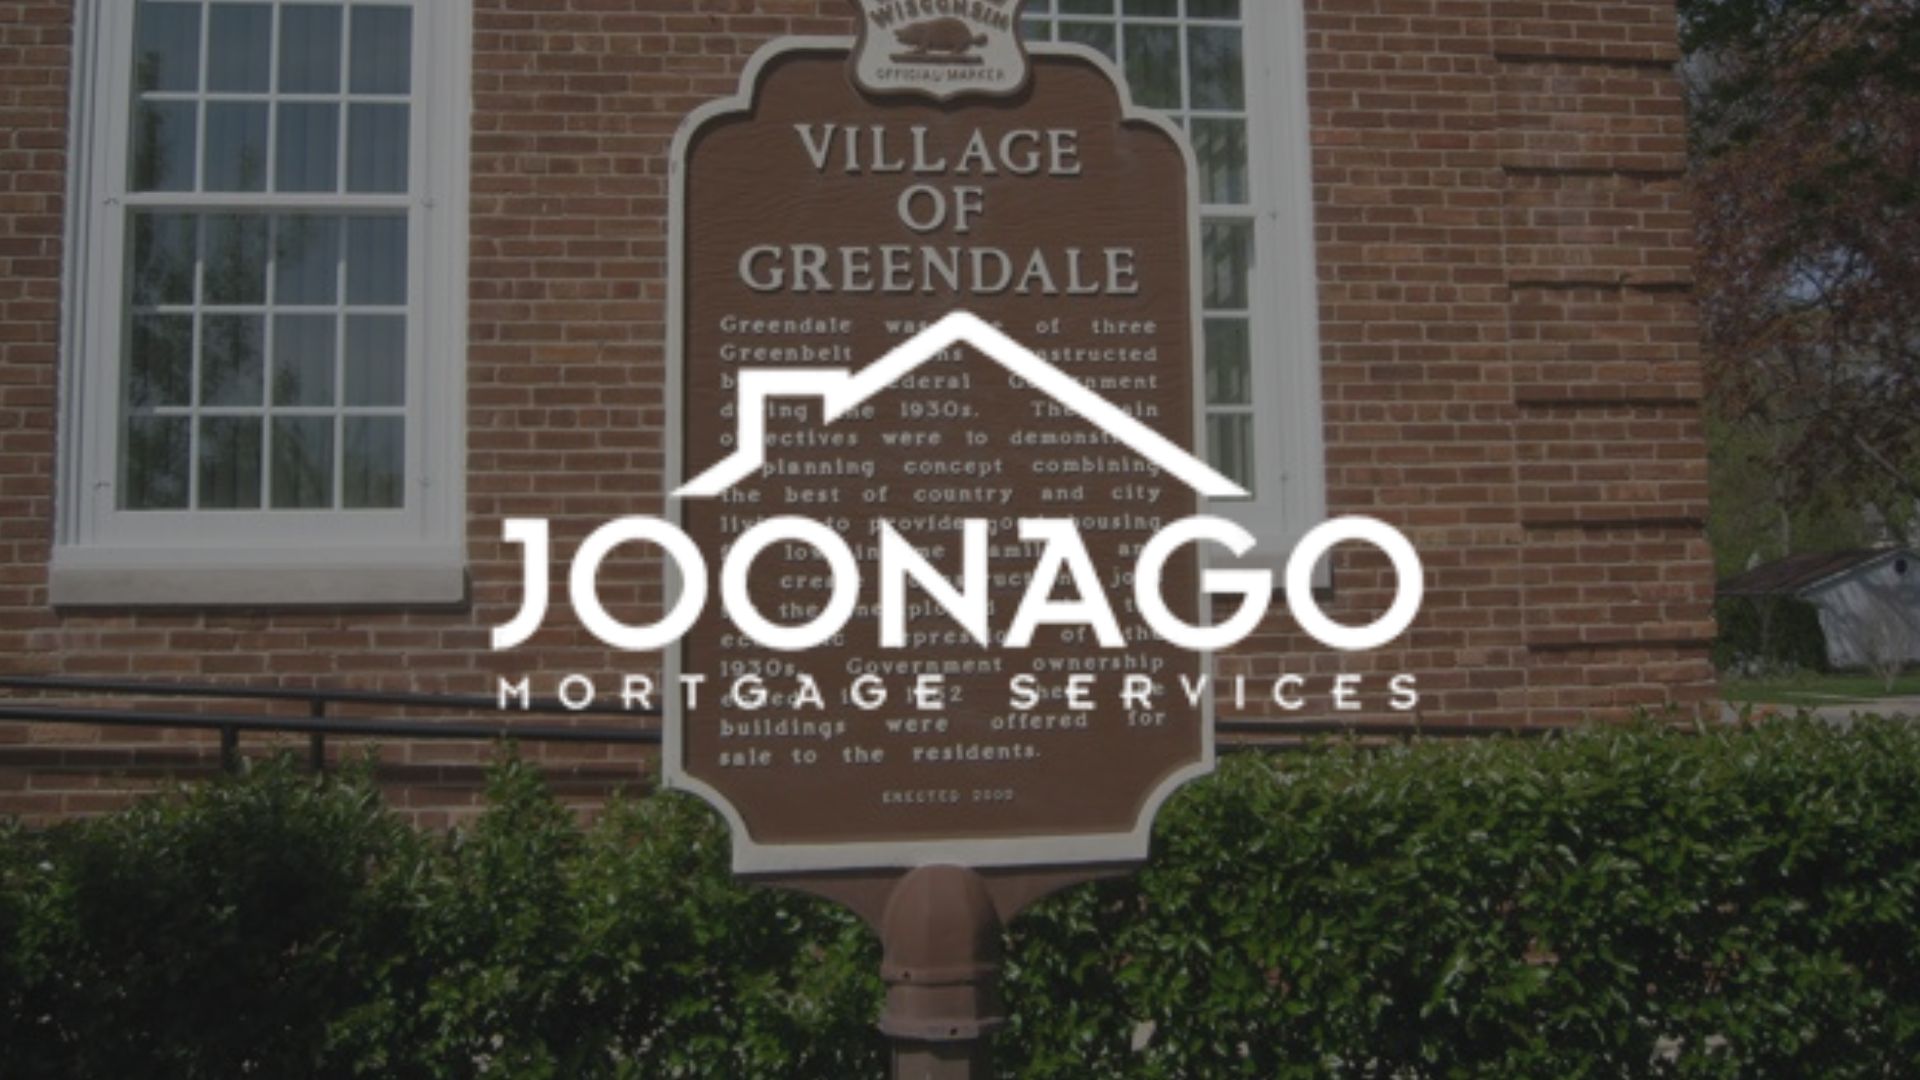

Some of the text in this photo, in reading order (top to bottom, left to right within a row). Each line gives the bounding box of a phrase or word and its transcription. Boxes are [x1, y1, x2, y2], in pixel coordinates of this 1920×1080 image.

[869, 0, 1009, 31] WISCONSIN
[794, 123, 1083, 176] VILLAGE
[897, 184, 985, 233] OF
[738, 243, 1140, 295] GREENDALE
[720, 316, 851, 334] Greendale
[1036, 317, 1060, 334] of
[1091, 317, 1157, 334] three
[720, 345, 851, 361] Greenbelt
[720, 401, 808, 423] ding
[901, 400, 979, 418] 1930s.
[720, 429, 859, 446] oectives
[882, 430, 941, 446] were
[966, 430, 988, 446] to
[763, 458, 875, 478] planning
[904, 458, 1004, 477] concept
[722, 483, 1160, 505] the best of country and city
[1061, 626, 1087, 643] of
[846, 658, 1002, 675] Government
[1033, 653, 1164, 672] ownership
[720, 708, 1166, 740] buildings were offered for
[720, 743, 1041, 767] sale to the residents.
